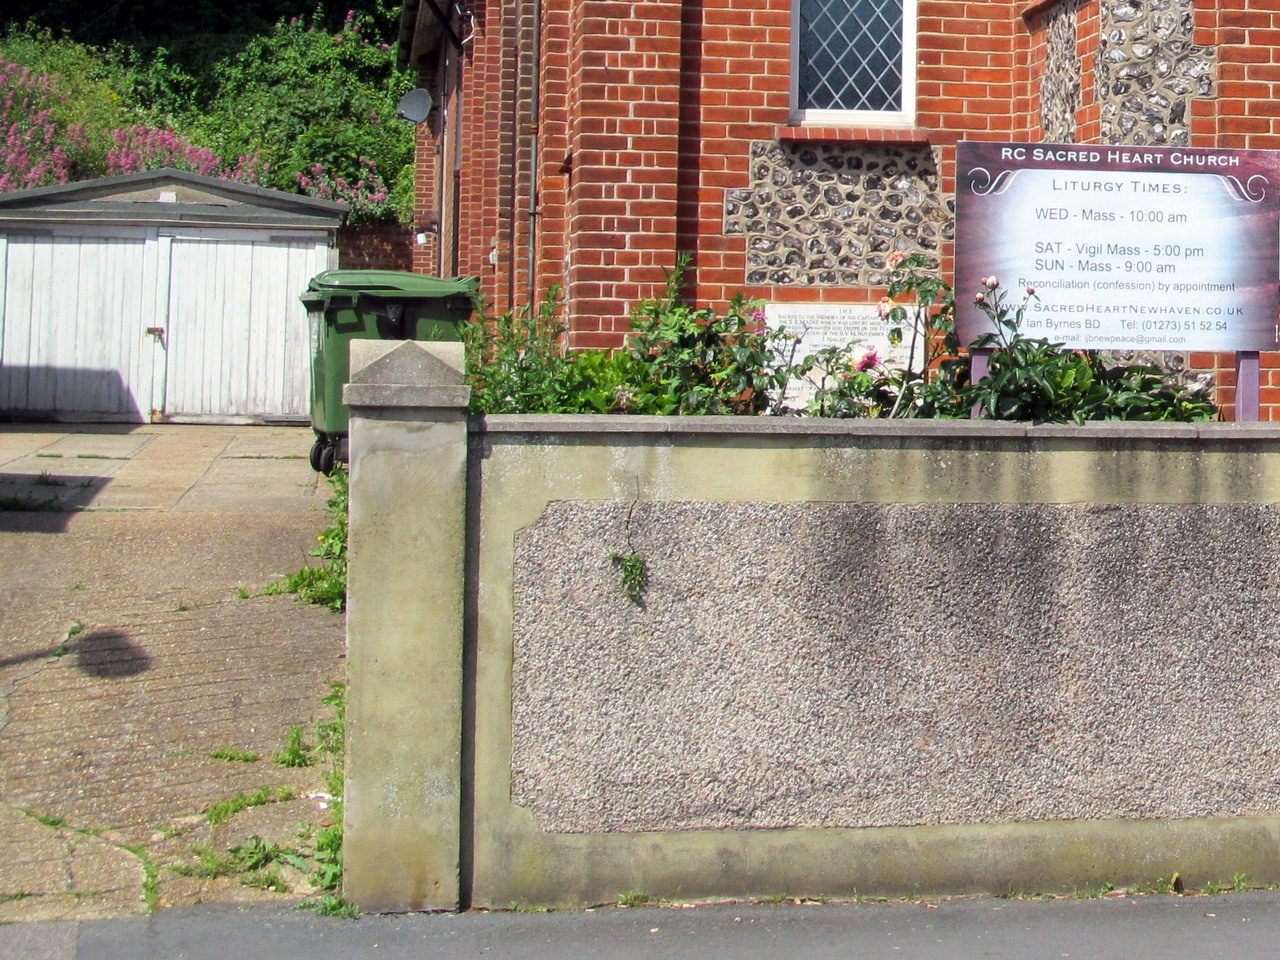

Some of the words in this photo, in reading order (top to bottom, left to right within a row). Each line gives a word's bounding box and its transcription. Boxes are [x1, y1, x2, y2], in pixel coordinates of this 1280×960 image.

[1001, 147, 1026, 160] RC
[1035, 207, 1069, 220] WED
[1081, 208, 1116, 222] Mass
[1129, 210, 1164, 223] 10:00
[1167, 213, 1187, 223] am
[1034, 241, 1063, 254] SAT
[1075, 242, 1103, 258] Vigil
[1106, 243, 1141, 256] Mass
[1153, 244, 1181, 257] 5:00
[1184, 246, 1204, 260] pm
[1034, 258, 1065, 271] SUN
[1077, 259, 1112, 272] Mass
[1124, 260, 1153, 273] 9:00
[1156, 263, 1176, 273] am
[1018, 277, 1090, 289] Reconciliation
[1092, 279, 1156, 293] (confession)
[1158, 280, 1171, 294] by
[1172, 282, 1236, 293] appointment
[1026, 318, 1043, 328] Ian
[1045, 318, 1082, 331] Byrnes
[1084, 319, 1101, 329] BD
[1119, 319, 1139, 330] Tel:
[1141, 320, 1181, 332] (01273)
[1183, 320, 1196, 330] 51
[1199, 320, 1212, 331] 52
[1215, 321, 1228, 331] 54
[1054, 334, 1082, 342] e-mail:
